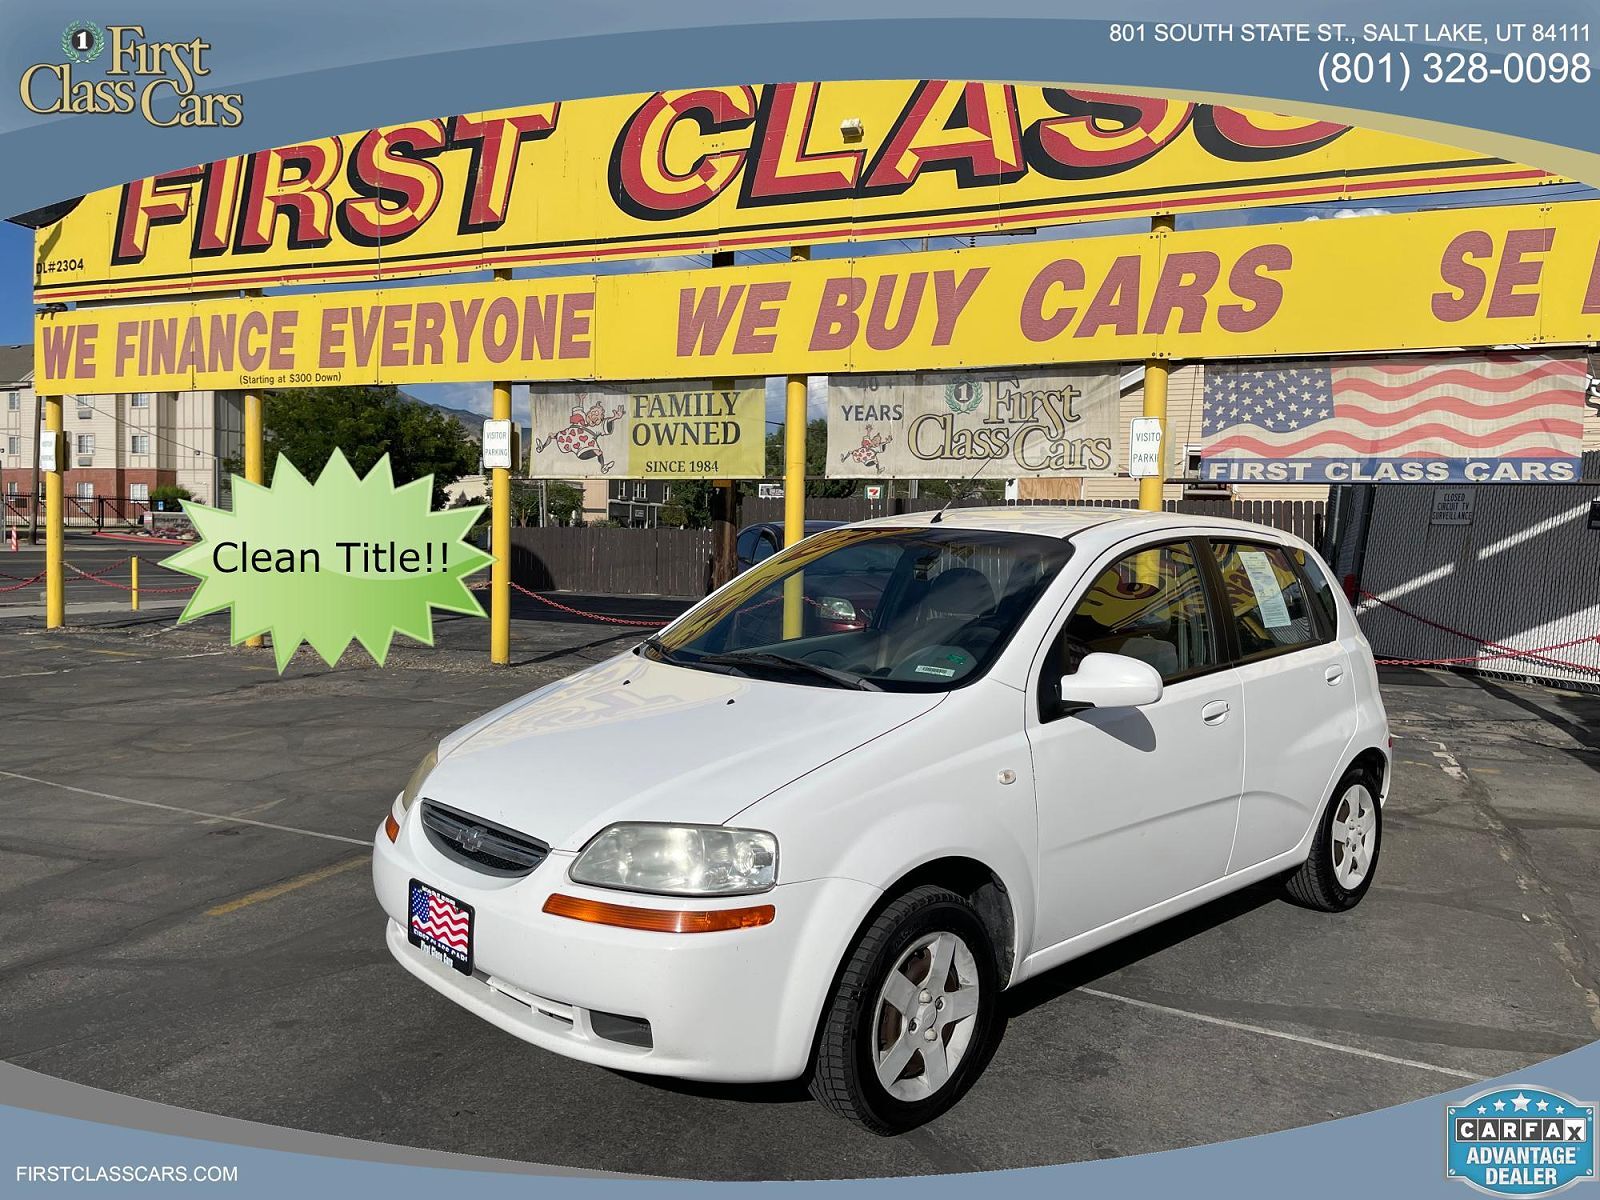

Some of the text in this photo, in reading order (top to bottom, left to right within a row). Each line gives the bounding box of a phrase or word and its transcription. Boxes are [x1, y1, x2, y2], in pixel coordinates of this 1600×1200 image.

[111, 101, 561, 266] FIRST
[36, 258, 84, 274] DL#2304
[1431, 228, 1557, 323] SE
[676, 244, 1293, 357] WE BUY CARS
[43, 292, 595, 380] WE FINANCE EVERYONE
[239, 371, 342, 386] (Starting at $300 Down)
[632, 391, 741, 418] FAMILY
[841, 404, 903, 421] YEARS
[983, 374, 1081, 440] First
[486, 431, 507, 441] VISITOR
[632, 420, 741, 447] OWNED
[908, 412, 1112, 471] Class Cars
[1136, 432, 1161, 442] VISITO
[485, 449, 508, 457] PARKING
[1133, 453, 1158, 463] PARKI
[645, 460, 719, 473] SINCE 1984
[1209, 461, 1575, 481] FIRST CLASS CARS
